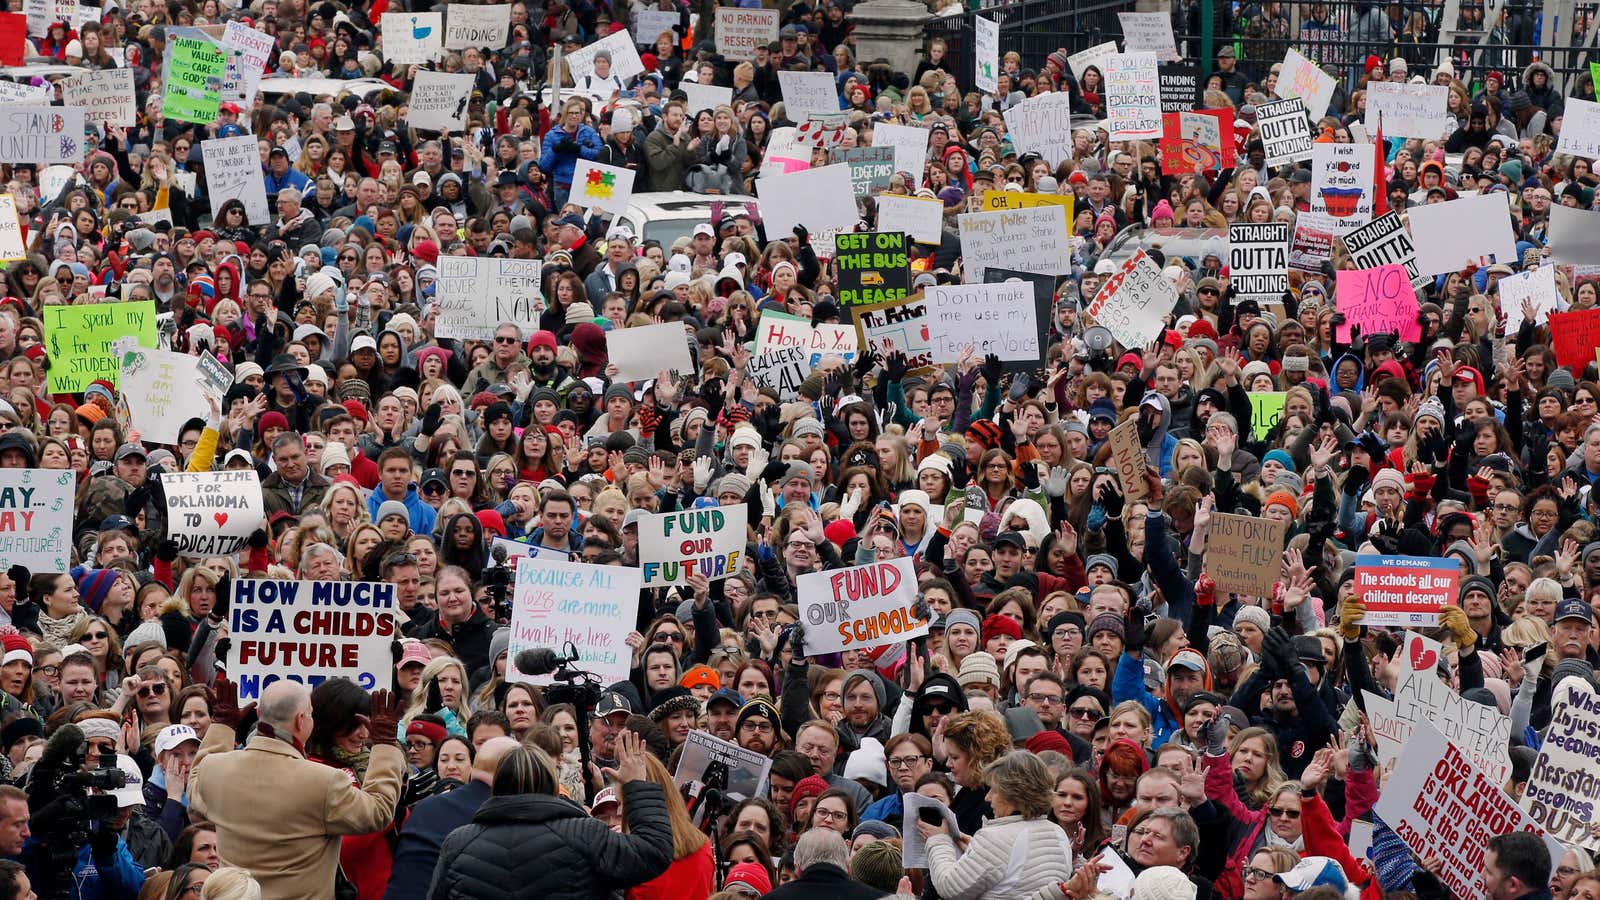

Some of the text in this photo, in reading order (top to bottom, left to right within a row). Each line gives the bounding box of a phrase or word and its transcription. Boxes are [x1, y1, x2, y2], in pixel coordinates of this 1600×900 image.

[722, 14, 773, 26] NO PARKING
[175, 39, 203, 50] FAMILY
[182, 73, 206, 84] GOD'S
[191, 62, 211, 74] CARE
[62, 69, 128, 92] NOW IS THE
[1161, 75, 1196, 86] FUNDING
[91, 95, 131, 107] OUTSIDE
[1109, 96, 1157, 107] EDUCATOR
[1257, 99, 1303, 119] STRAIGHT
[1261, 116, 1307, 140] OUTTA
[1265, 136, 1312, 158] FUNDING
[1338, 147, 1353, 155] wish
[1338, 176, 1356, 184] much
[991, 197, 1008, 208] OH
[1358, 205, 1369, 213] did
[837, 234, 869, 250] GET
[876, 234, 902, 249] ON
[1230, 225, 1287, 241] STRAIGHT
[1345, 213, 1400, 251] STRAIGHT
[837, 253, 907, 269] THE BUS
[1231, 247, 1286, 271] OUTTA
[1357, 234, 1415, 270] OUTTA
[496, 278, 540, 288] THE TIME
[1231, 275, 1287, 293] FUNDING
[1363, 267, 1401, 302] NO
[839, 288, 907, 305] PLEASE
[936, 288, 1025, 307] Don't make
[55, 307, 144, 332] I spend my
[496, 296, 540, 322] NOW
[940, 310, 1028, 323] me use my
[1342, 302, 1388, 320] THANK
[860, 311, 885, 329] The
[72, 335, 89, 354] for
[811, 330, 826, 349] Do
[831, 330, 852, 351] You
[934, 329, 1037, 353] Teacher Voice
[747, 347, 804, 373] TEACHERS
[55, 376, 80, 392] Why
[1115, 431, 1124, 443] IS
[1127, 419, 1138, 447] THE
[1117, 447, 1140, 494] NOW
[1134, 448, 1146, 485] TIME
[164, 471, 252, 484] IT'S TIME
[196, 483, 222, 493] FOR
[168, 494, 250, 509] OKLAHOMA
[183, 512, 202, 528] TO
[663, 509, 725, 537] FUND
[1211, 515, 1277, 543] HISTORIC
[172, 533, 251, 555] EDUCATION
[680, 537, 713, 556] OUR
[1241, 543, 1277, 569] FULLY
[1396, 559, 1431, 568] DEMAND:
[519, 564, 616, 590] Because ALL
[643, 551, 740, 583] FUTURE
[1216, 563, 1258, 584] funding
[831, 563, 902, 602] FUND
[1360, 572, 1452, 589] The schools all our
[235, 580, 393, 608] HOW MUCH
[1363, 590, 1449, 605] children deserve!
[558, 599, 582, 615] are
[807, 600, 852, 626] OUR
[232, 608, 394, 637] IS A CHILD'S
[522, 625, 558, 645] walk
[563, 627, 584, 644] the
[239, 641, 359, 667] FUTURE
[1399, 672, 1512, 742] ALL MY EXS
[1443, 717, 1464, 741] IN
[1466, 726, 1509, 765] TEXAS
[1444, 741, 1521, 826] The future
[1422, 772, 1469, 828] is in my
[1527, 780, 1593, 822] becomes
[1412, 792, 1460, 848] but the
[1528, 800, 1592, 844] DUTY
[1395, 819, 1426, 856] 2300
[1424, 828, 1474, 882] is found
